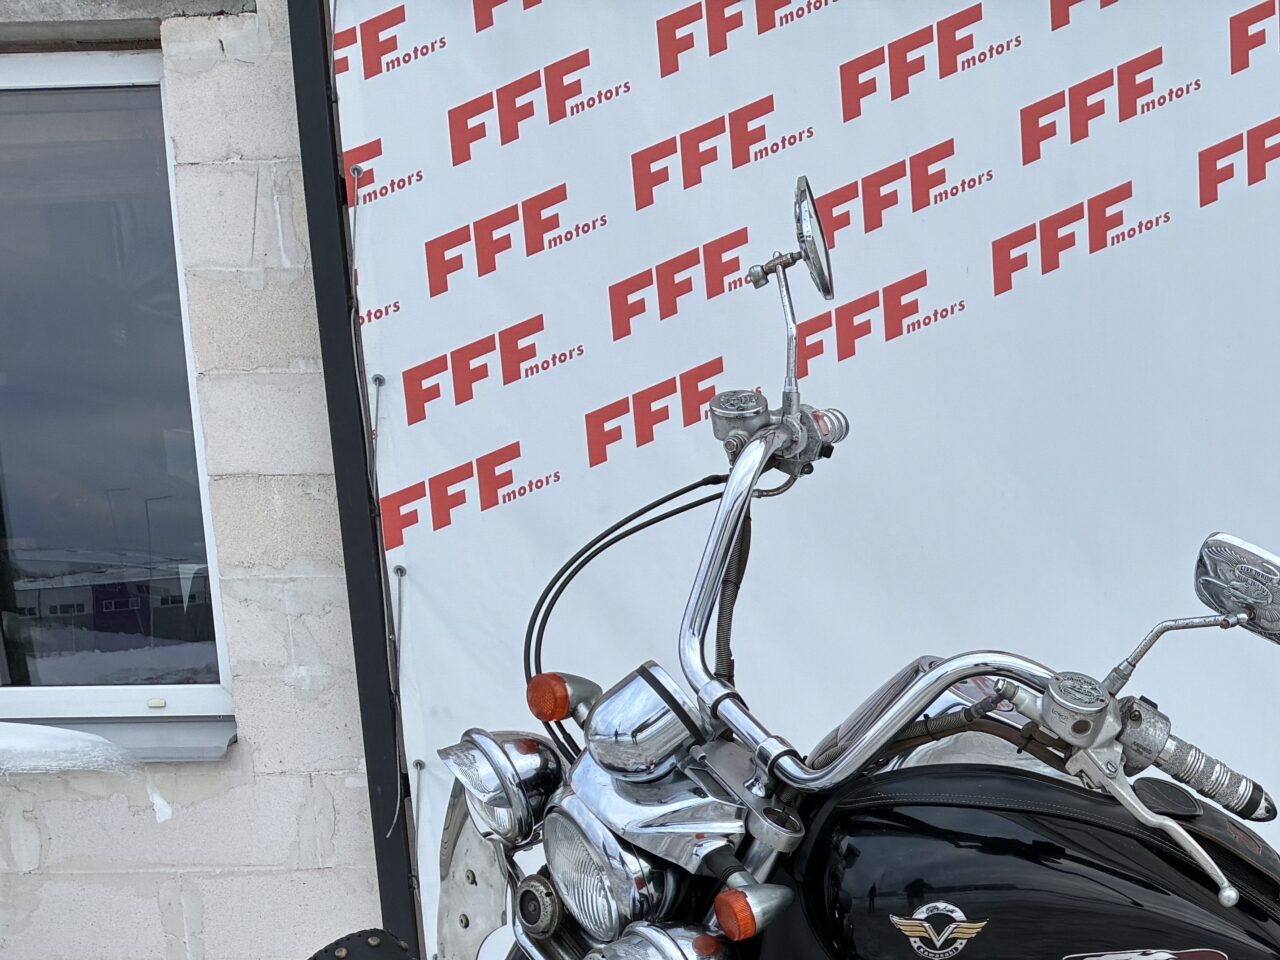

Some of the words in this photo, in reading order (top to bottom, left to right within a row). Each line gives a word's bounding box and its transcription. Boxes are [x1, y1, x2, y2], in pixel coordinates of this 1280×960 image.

[386, 36, 447, 73] motors
[447, 49, 591, 166] FFF
[570, 81, 631, 117] motors
[839, 3, 984, 124] FFF
[961, 35, 1022, 73] motors
[1019, 46, 1164, 166] FFF
[1140, 79, 1201, 115] motors
[362, 169, 424, 205] motors
[631, 94, 775, 212] FFF
[753, 126, 814, 162] motors
[814, 138, 956, 251] FFF
[933, 168, 994, 205] motors
[424, 183, 569, 298] FFF
[548, 214, 608, 250] motors
[608, 227, 750, 342] FFF
[991, 180, 1134, 297] FFF
[1110, 211, 1171, 247] motors
[402, 313, 545, 426] FFF
[524, 345, 585, 380] motors
[796, 269, 929, 380] FFF
[906, 300, 966, 334] motors
[585, 356, 725, 468] FFF
[378, 440, 522, 552] FFF
[502, 470, 561, 505] motors
